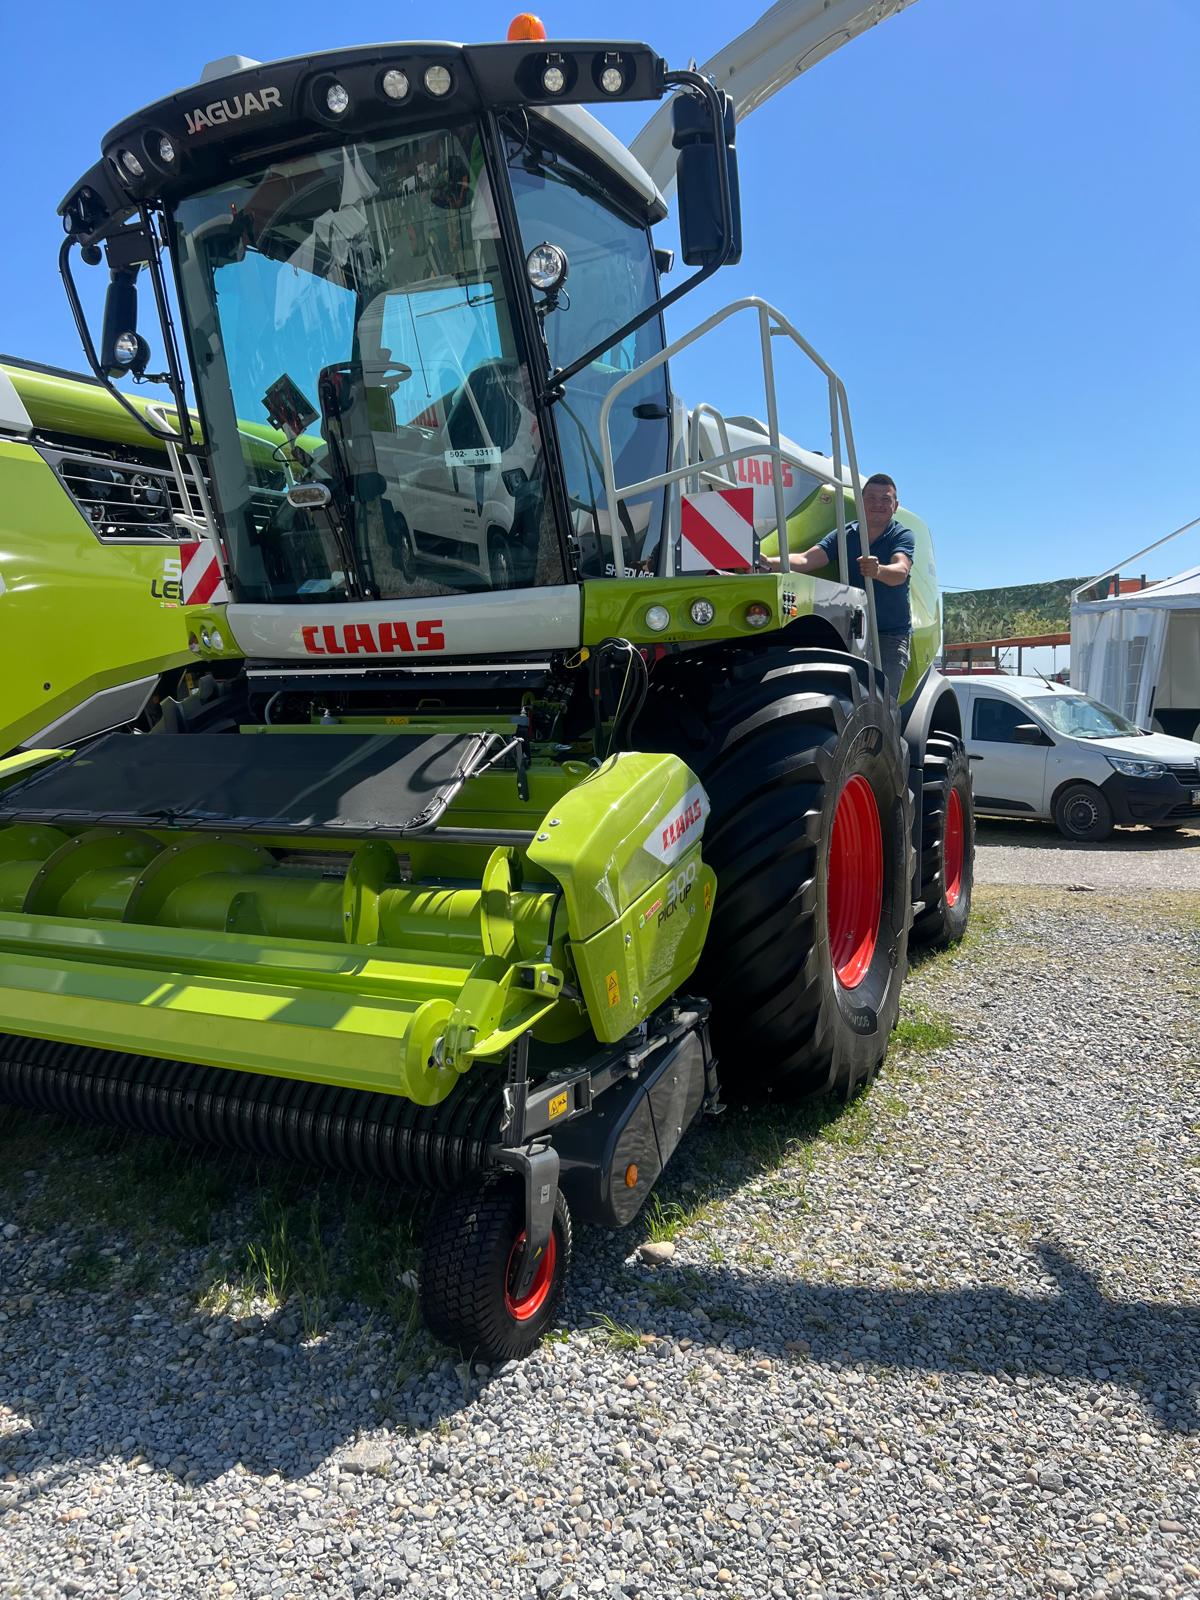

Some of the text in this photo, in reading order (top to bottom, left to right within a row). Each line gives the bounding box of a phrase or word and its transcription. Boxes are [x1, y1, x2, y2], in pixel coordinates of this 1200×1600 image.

[184, 86, 283, 135] JAGUAR
[736, 457, 793, 488] LAAS
[151, 579, 181, 600] LE
[302, 619, 445, 654] CLAAS
[662, 798, 702, 851] CLAAS
[667, 862, 696, 904] 300
[658, 883, 692, 928] PICK UP
